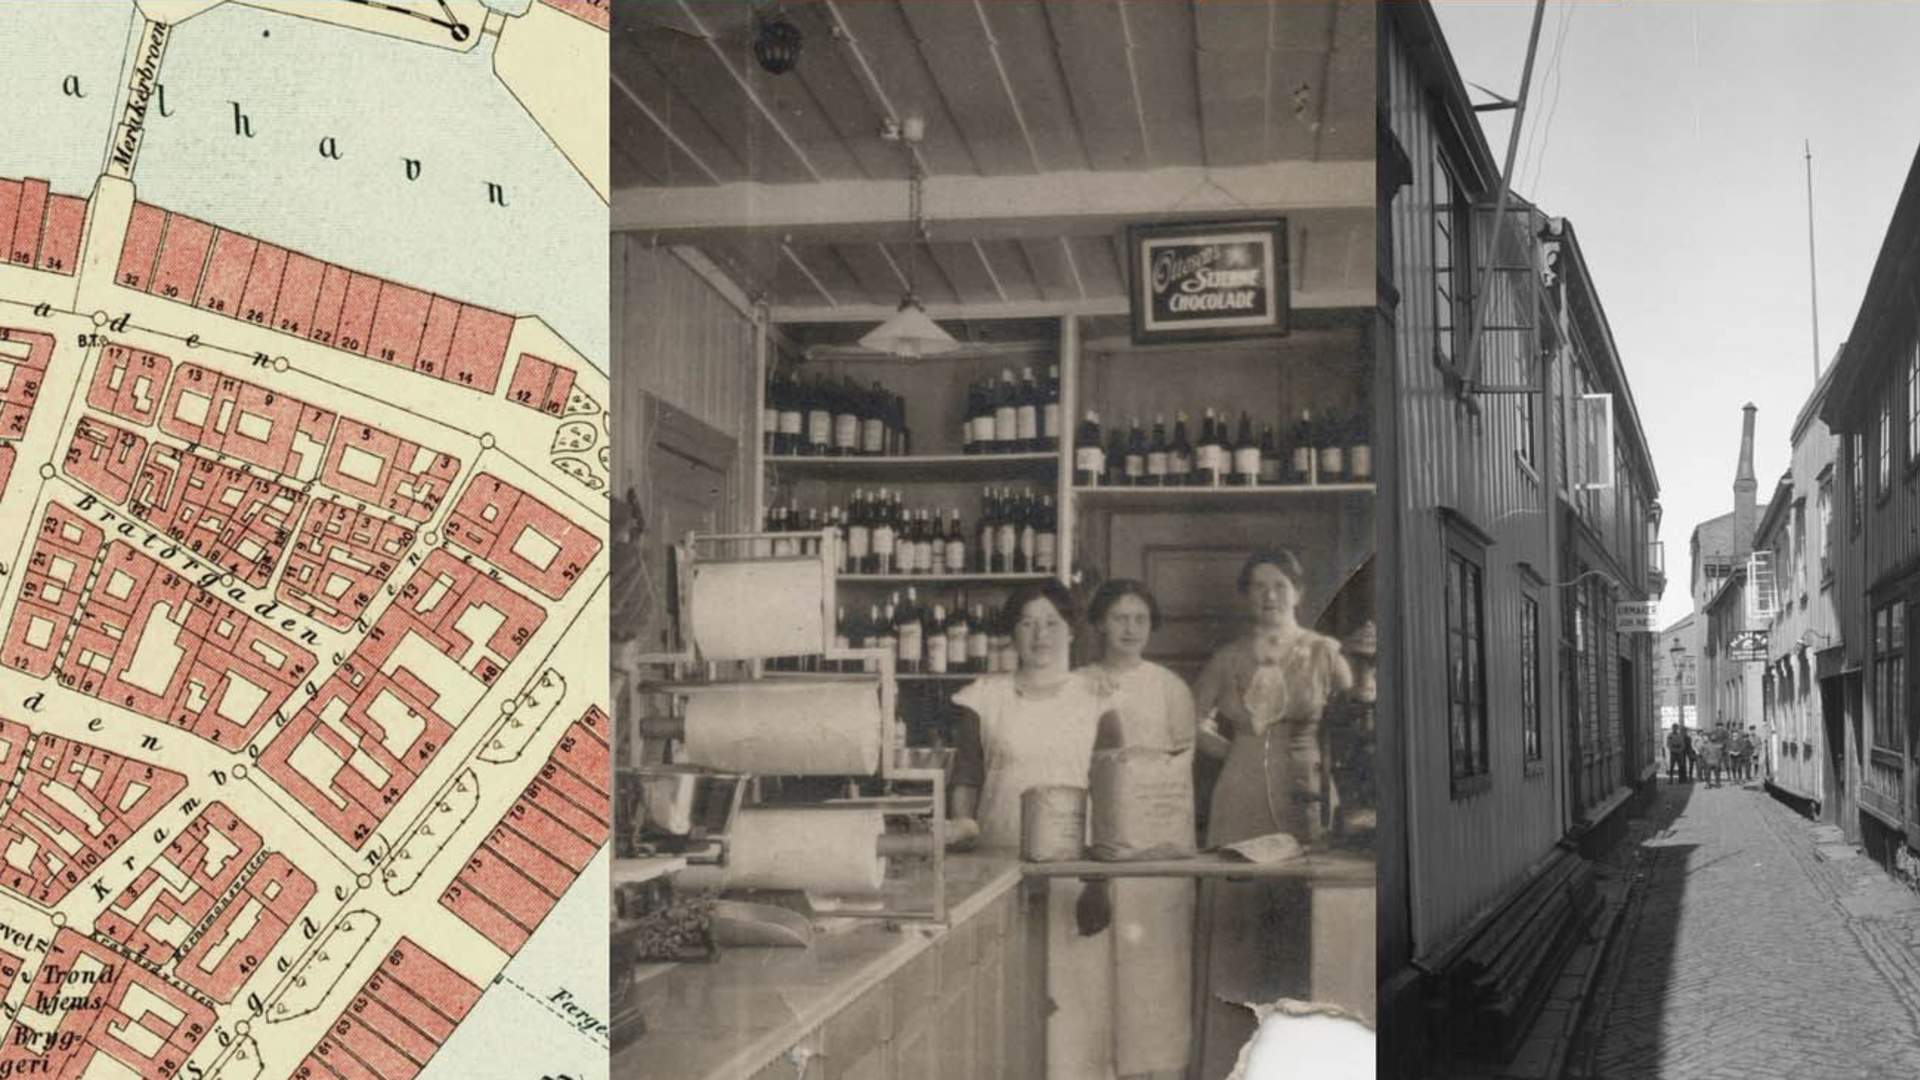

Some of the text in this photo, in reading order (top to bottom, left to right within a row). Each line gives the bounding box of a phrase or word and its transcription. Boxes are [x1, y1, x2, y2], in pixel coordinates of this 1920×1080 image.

[124, 273, 139, 286] 32
[163, 284, 178, 297] 30
[208, 297, 224, 311] 28
[562, 562, 581, 581] 52
[511, 627, 530, 646] 50
[14, 657, 29, 669] 12
[483, 666, 498, 682] 48
[126, 696, 134, 706] 6
[585, 709, 601, 727] 87
[212, 729, 221, 741] 2
[419, 741, 436, 760] 46
[560, 736, 576, 753] 85
[383, 787, 399, 804] 44
[354, 824, 370, 840] 42
[102, 834, 119, 850] 12
[81, 854, 98, 869] 10
[467, 858, 483, 873] 75
[66, 871, 78, 883] 8
[445, 886, 462, 903] 73
[238, 955, 258, 975] 40
[43, 965, 114, 984] Trond
[36, 990, 101, 1015] hjems
[184, 1023, 204, 1043] 38
[0, 1055, 49, 1079] geri
[158, 1059, 176, 1077] 36
